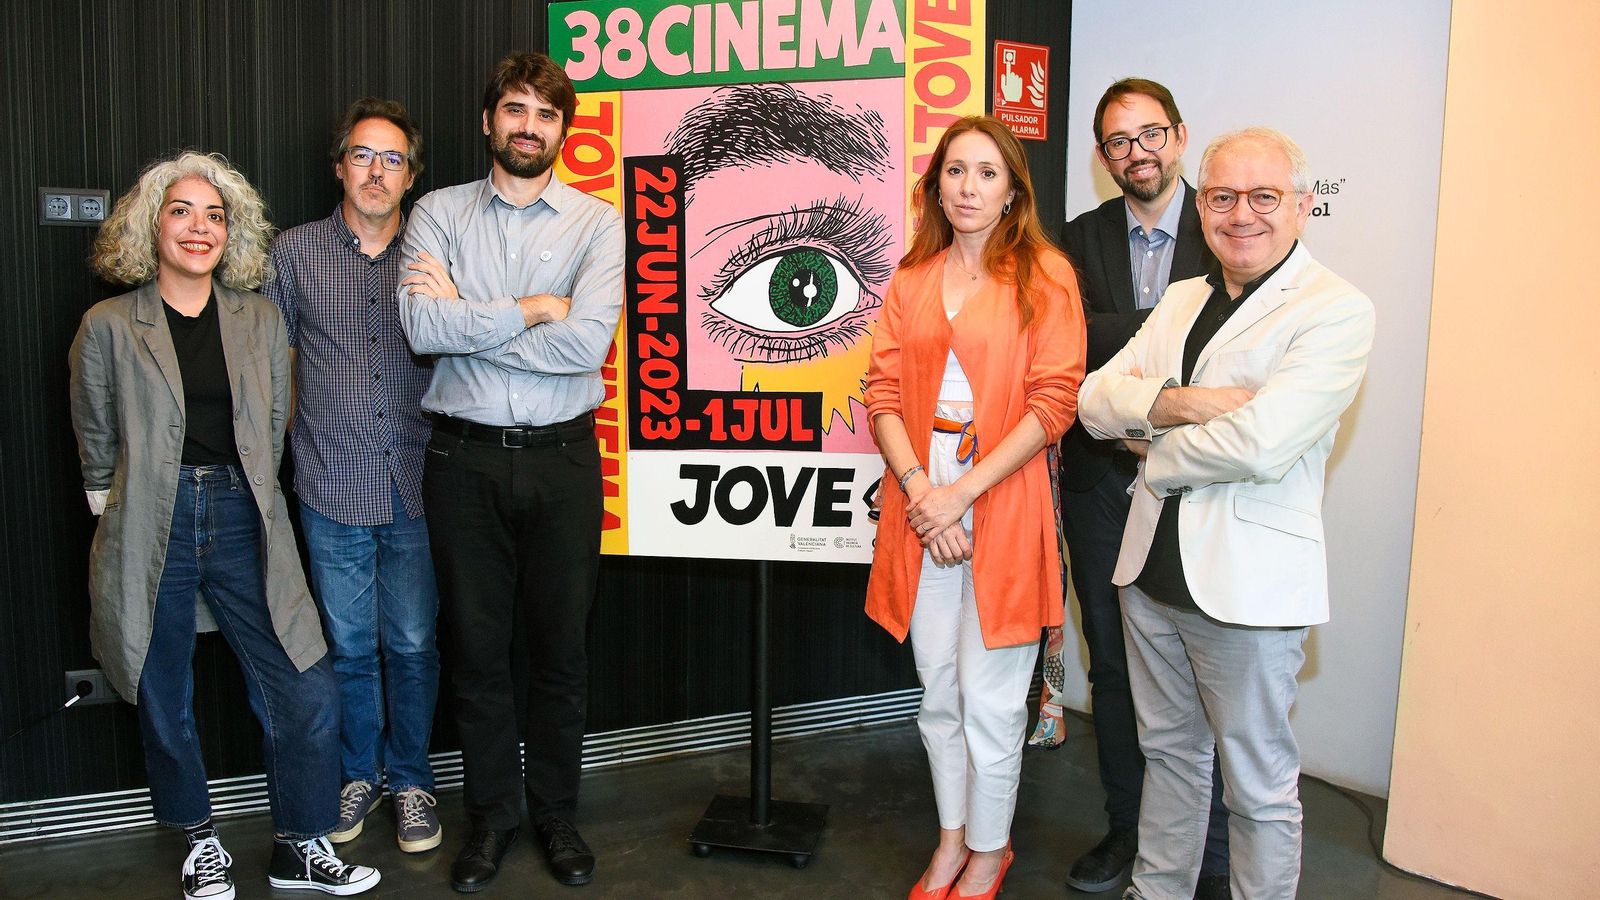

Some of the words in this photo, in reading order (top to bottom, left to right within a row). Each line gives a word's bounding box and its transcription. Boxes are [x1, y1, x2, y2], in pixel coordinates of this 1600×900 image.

[1001, 113, 1038, 125] PULSADOR
[1011, 125, 1040, 136] ALARMA
[1308, 202, 1331, 217] ol
[670, 463, 856, 527] JOVE
